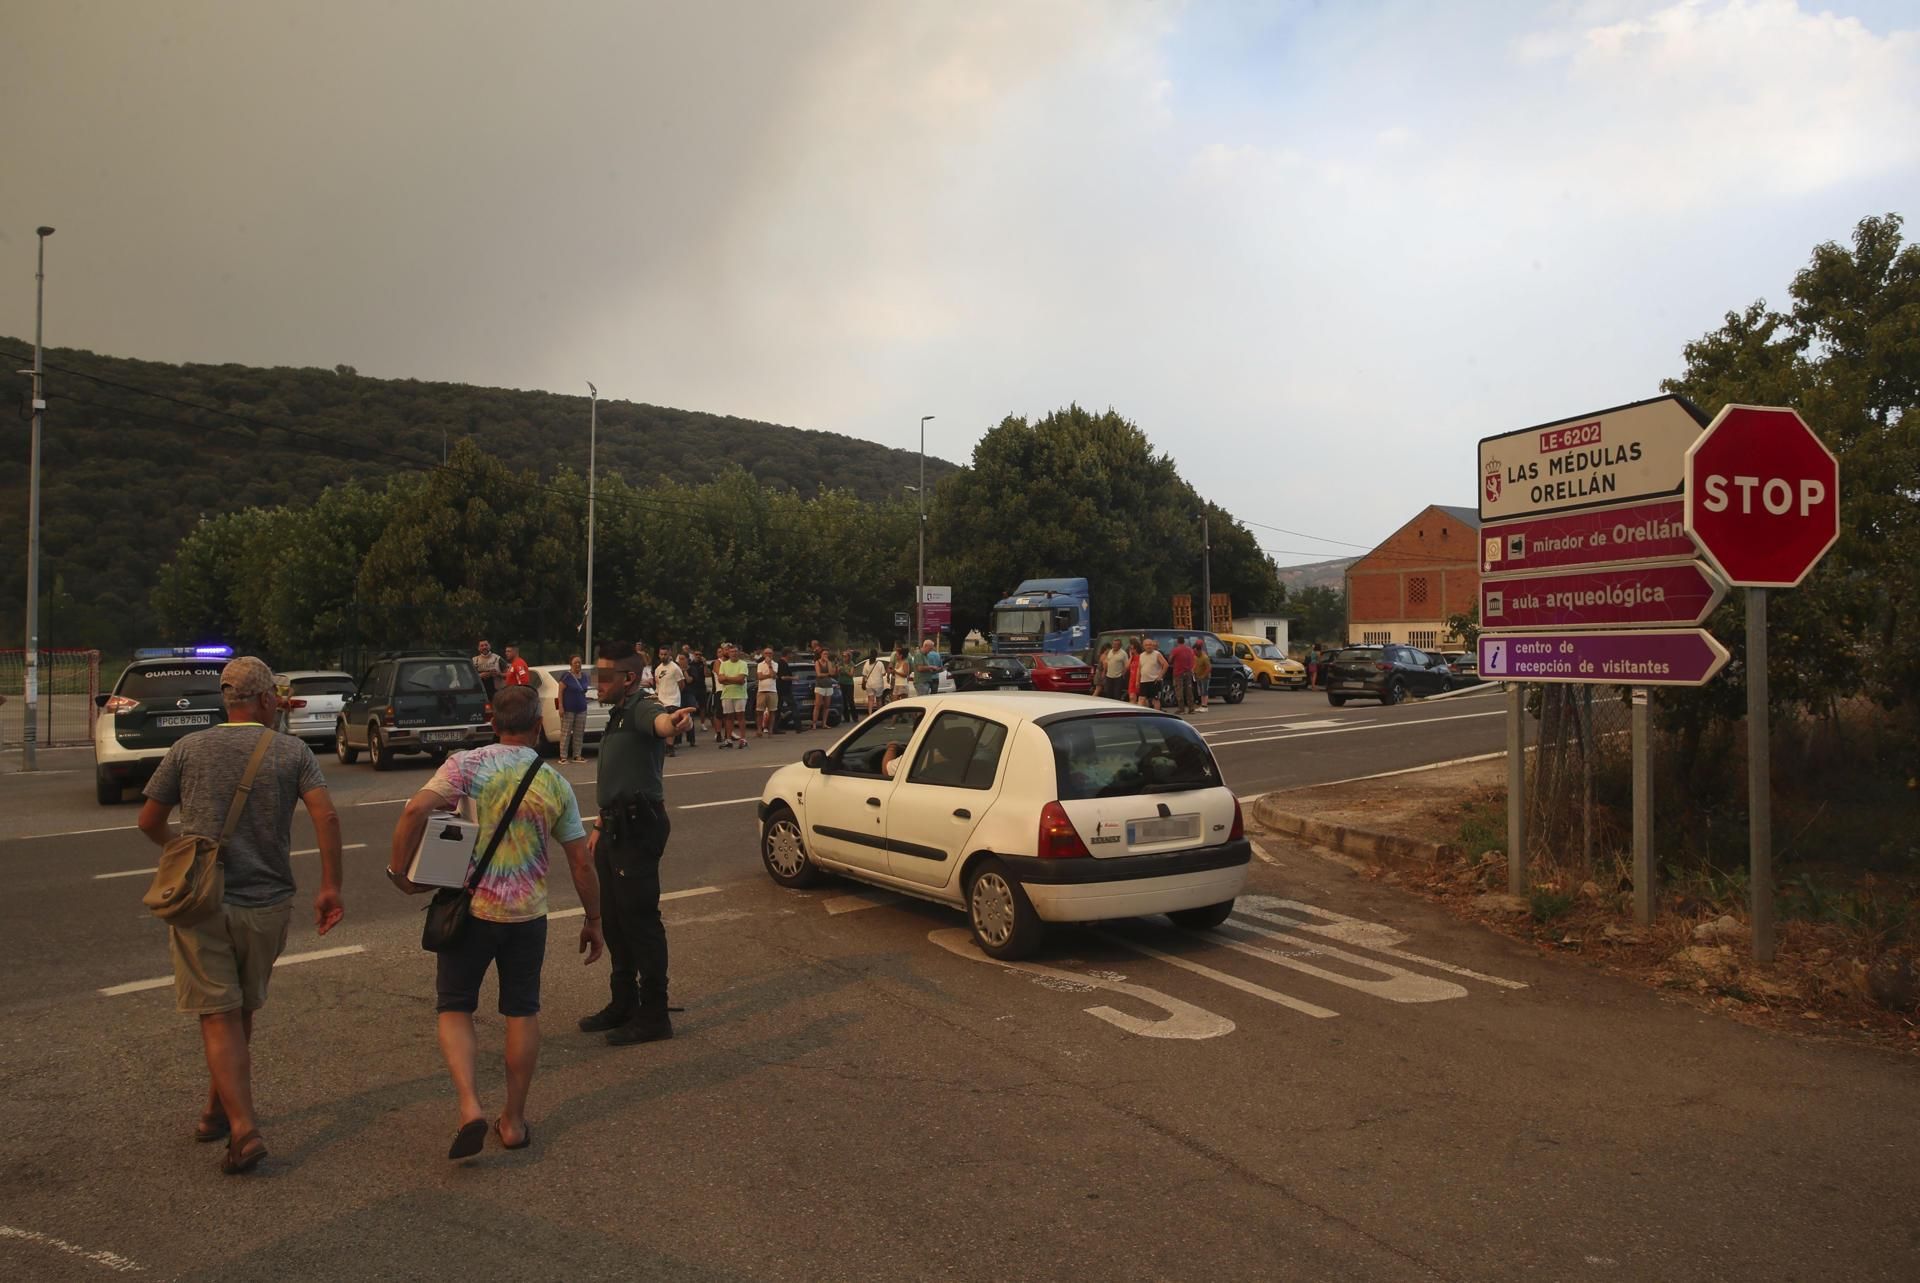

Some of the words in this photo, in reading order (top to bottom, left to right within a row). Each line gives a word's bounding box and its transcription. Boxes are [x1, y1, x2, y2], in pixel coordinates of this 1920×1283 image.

[1541, 425, 1600, 451] LE-6202
[1508, 462, 1539, 484] LAS
[1550, 442, 1642, 476] MÉDULAS
[1531, 472, 1616, 503] ORELLÁN
[1703, 474, 1825, 517] STOP
[1533, 536, 1584, 553] mirador
[1590, 532, 1607, 546] de
[1613, 518, 1684, 544] Orellán
[1512, 595, 1540, 609] aula
[1546, 583, 1665, 611] arqueológica
[1515, 641, 1552, 654] centro
[1559, 640, 1574, 653] de
[145, 670, 192, 679] GUARDIA
[1515, 659, 1571, 675] recepción
[1579, 659, 1594, 673] de
[1602, 659, 1670, 674] visitantes
